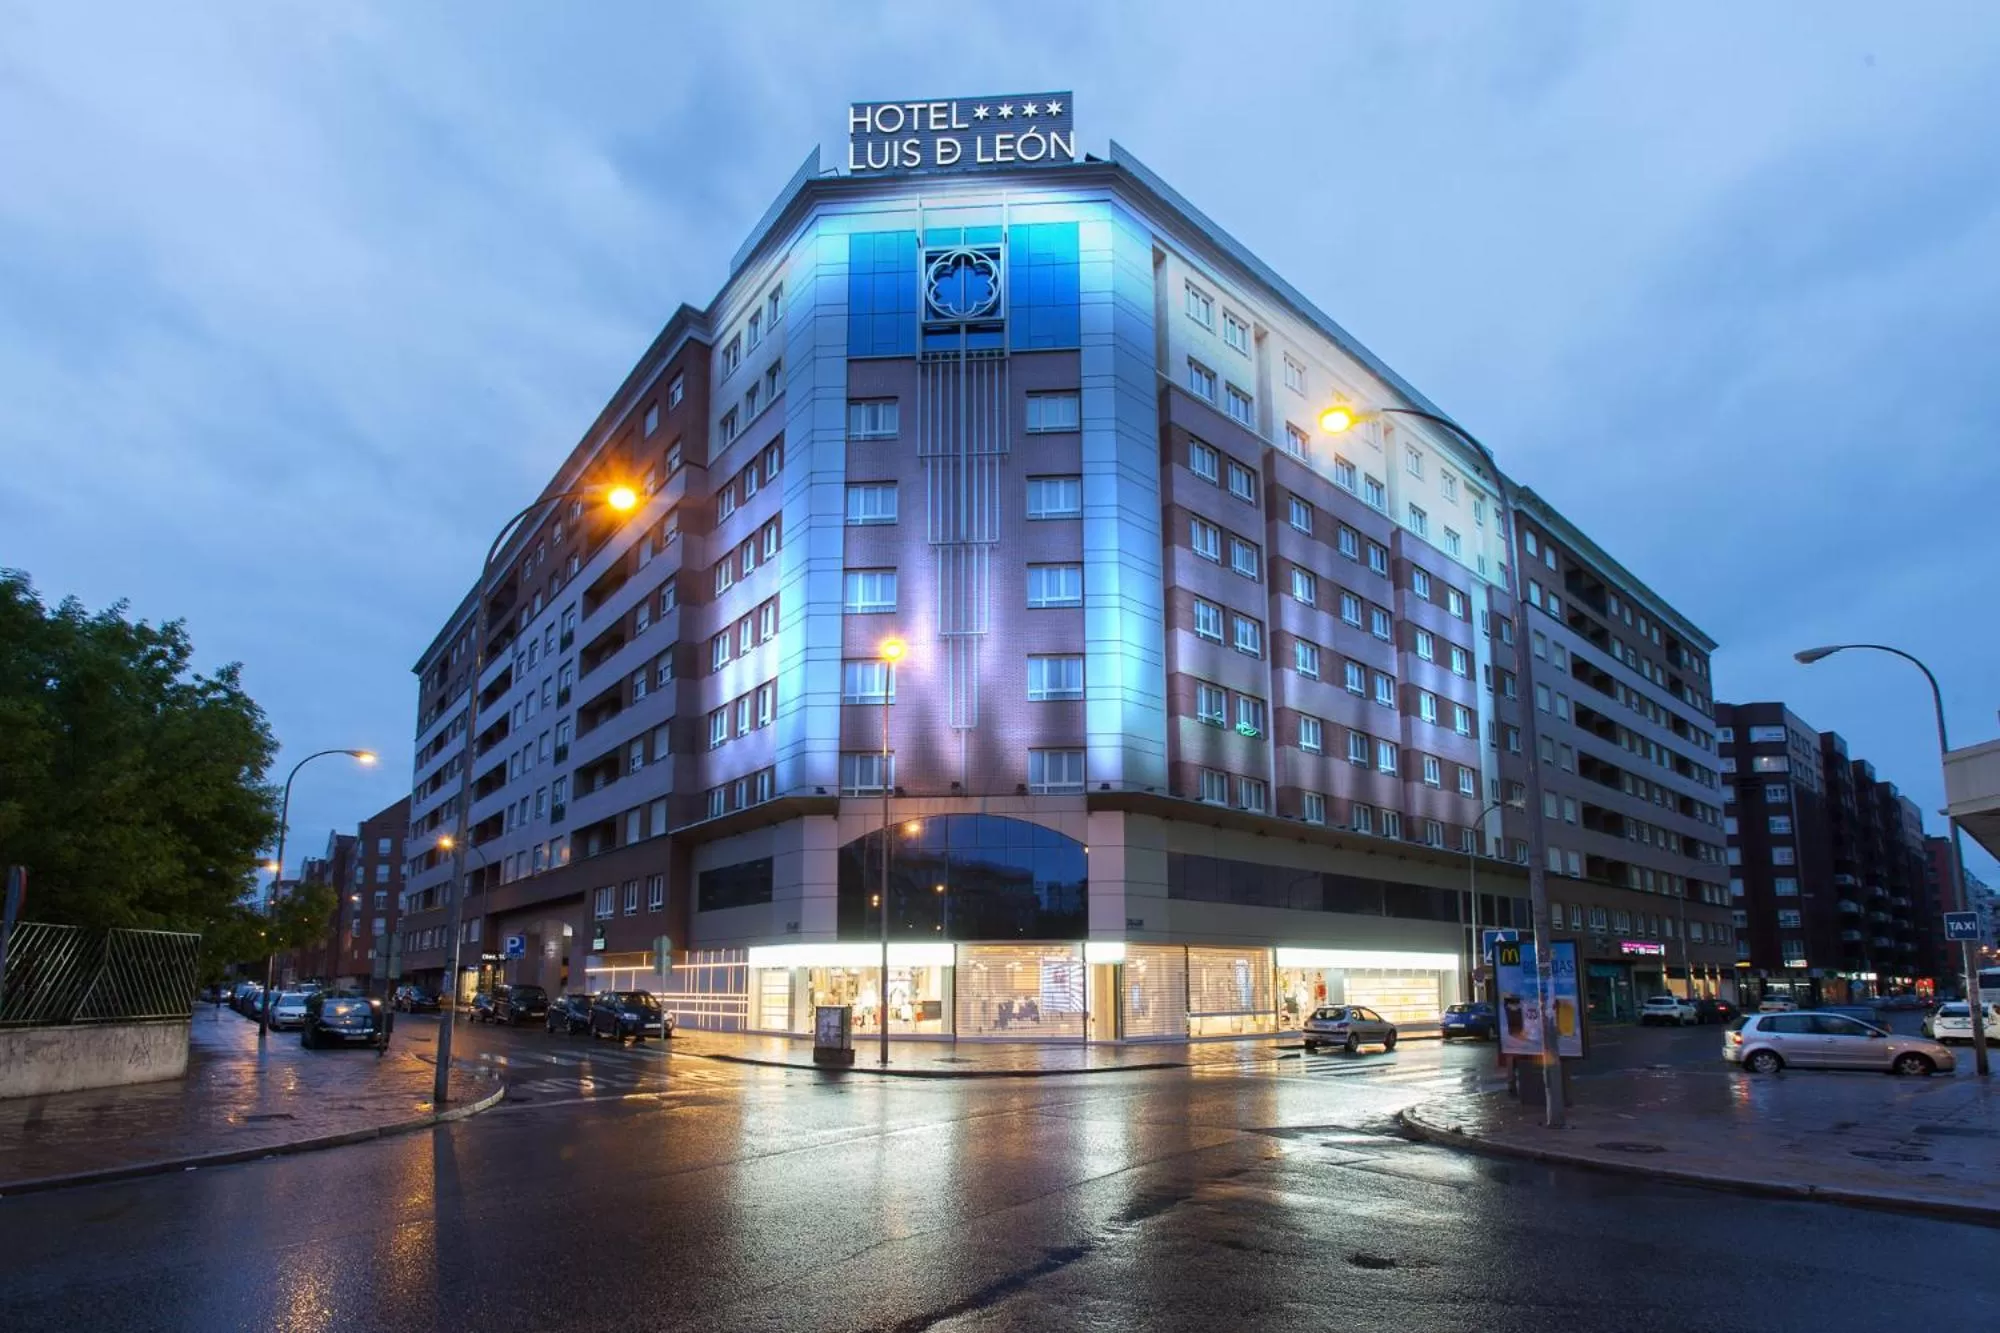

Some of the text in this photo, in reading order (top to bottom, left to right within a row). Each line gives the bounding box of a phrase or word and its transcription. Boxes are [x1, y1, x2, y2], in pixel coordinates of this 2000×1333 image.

[849, 101, 969, 133] HOTEL
[849, 138, 921, 170] LUIS
[976, 126, 1075, 163] LEÓN
[1948, 921, 1976, 931] TAXI
[507, 936, 521, 953] P
